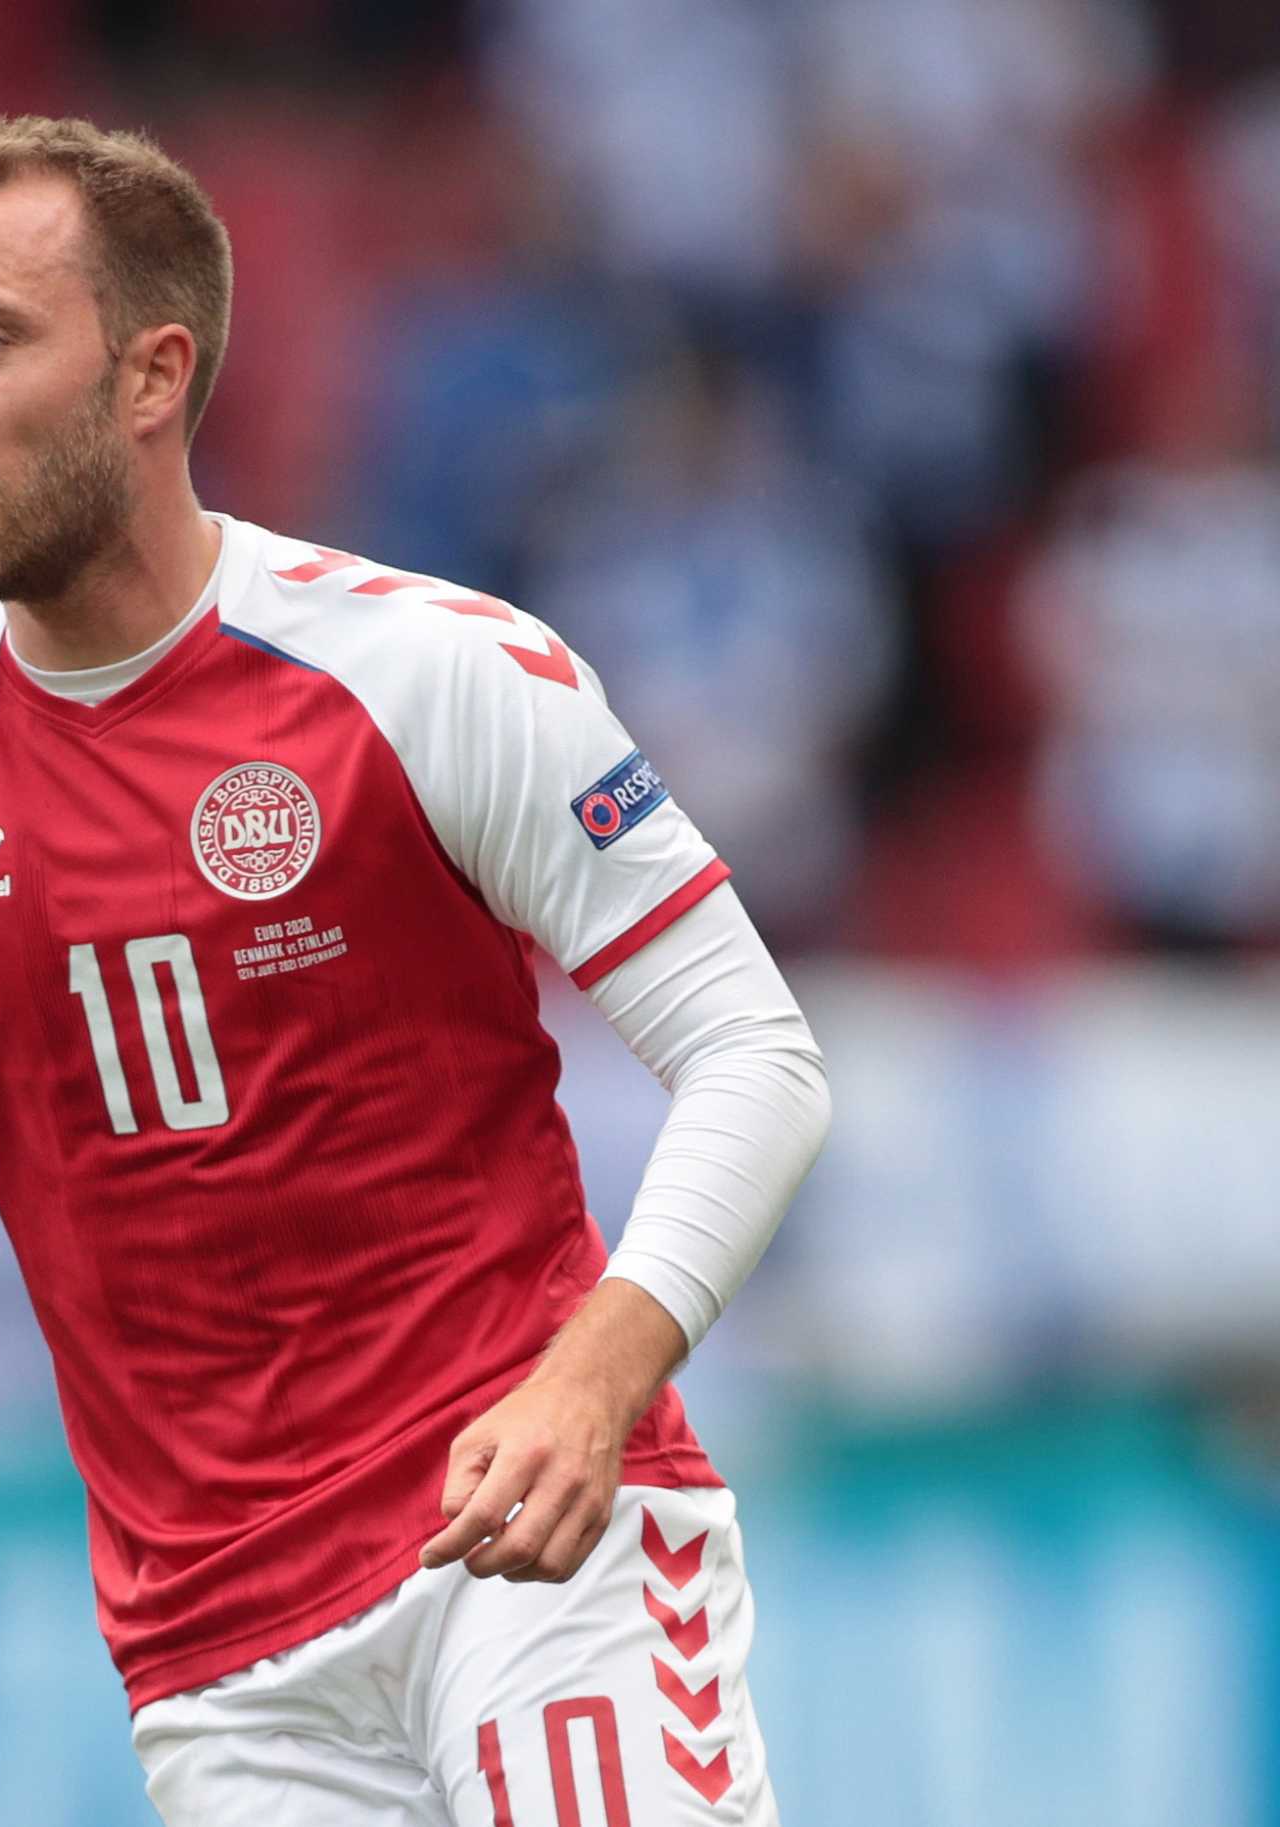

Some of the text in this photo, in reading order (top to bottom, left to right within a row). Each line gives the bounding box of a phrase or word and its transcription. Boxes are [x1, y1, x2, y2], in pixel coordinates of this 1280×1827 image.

[200, 809, 231, 882] DANSK
[222, 809, 293, 850] DBU
[237, 875, 287, 892] 1889
[234, 943, 285, 965] DENMARK
[297, 926, 343, 952] FINLAND
[255, 917, 313, 941] EURO 2020
[69, 933, 229, 1135] 10
[477, 1696, 631, 1827] 10
